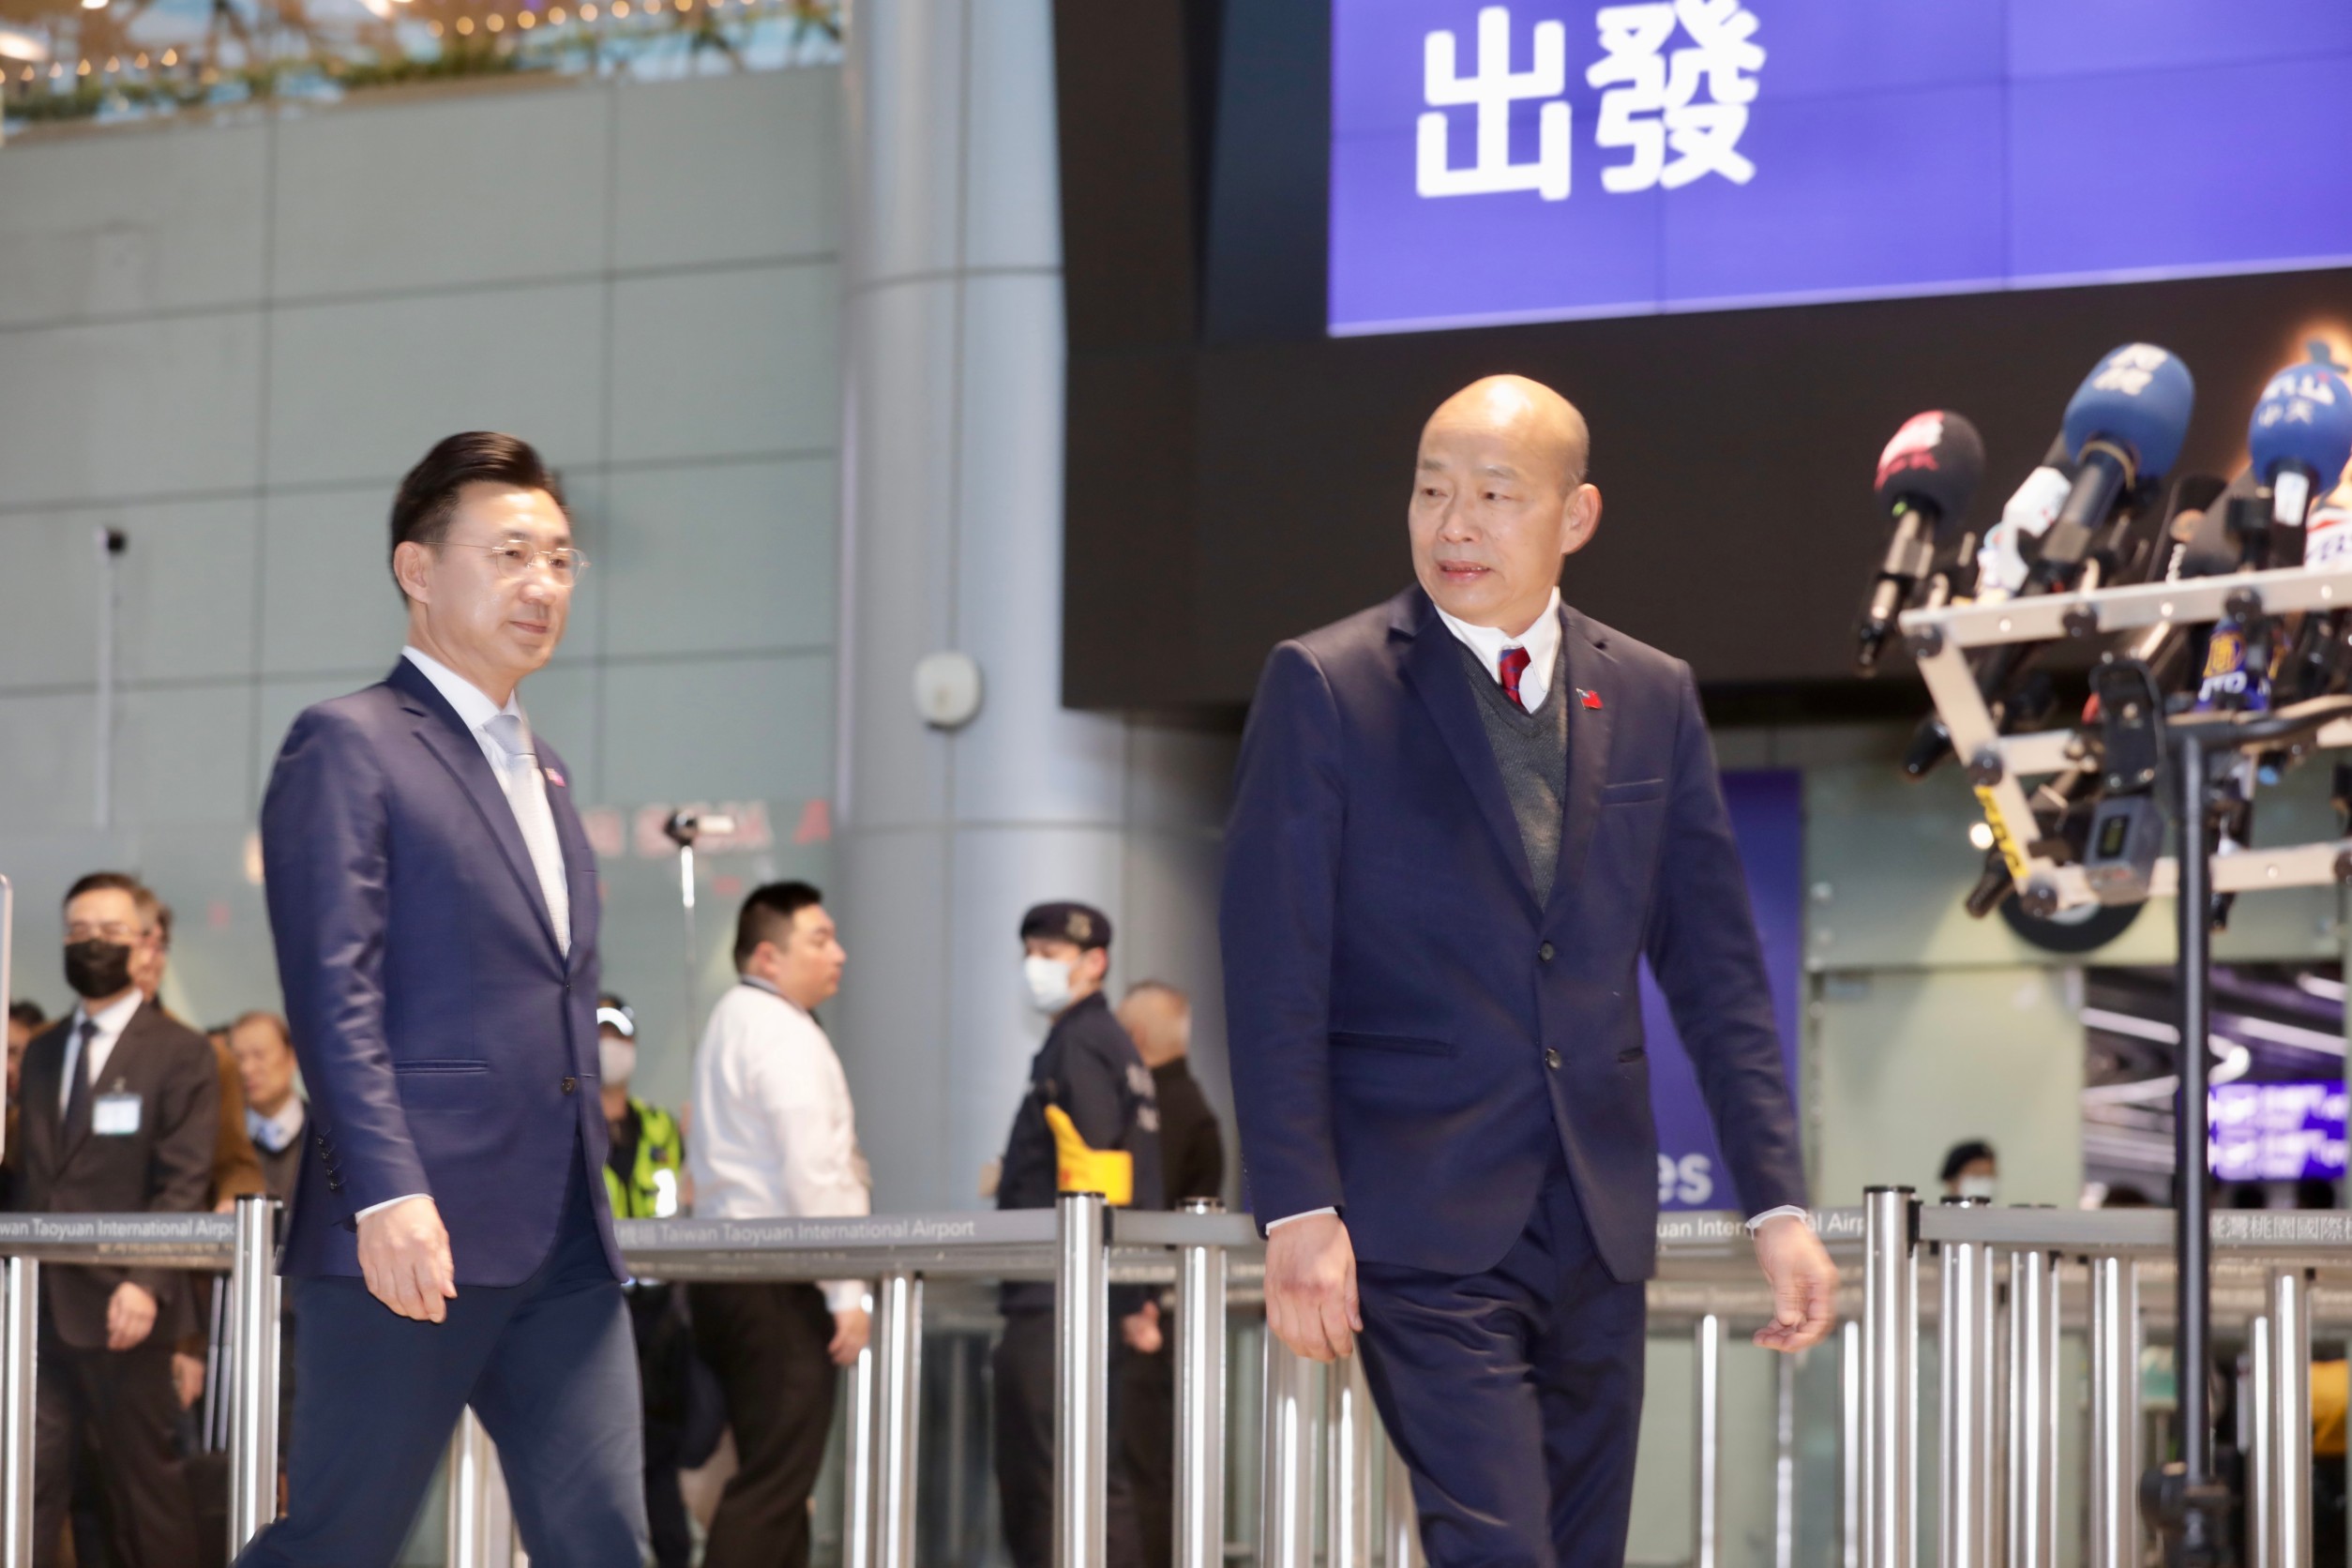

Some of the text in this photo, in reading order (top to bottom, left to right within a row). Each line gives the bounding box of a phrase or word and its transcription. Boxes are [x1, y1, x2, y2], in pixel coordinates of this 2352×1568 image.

[1416, 0, 1767, 201] 出發
[32, 1217, 93, 1241] Taoyuan
[98, 1218, 192, 1237] International
[661, 1218, 975, 1246] Taiwan Taoyuan International Airport
